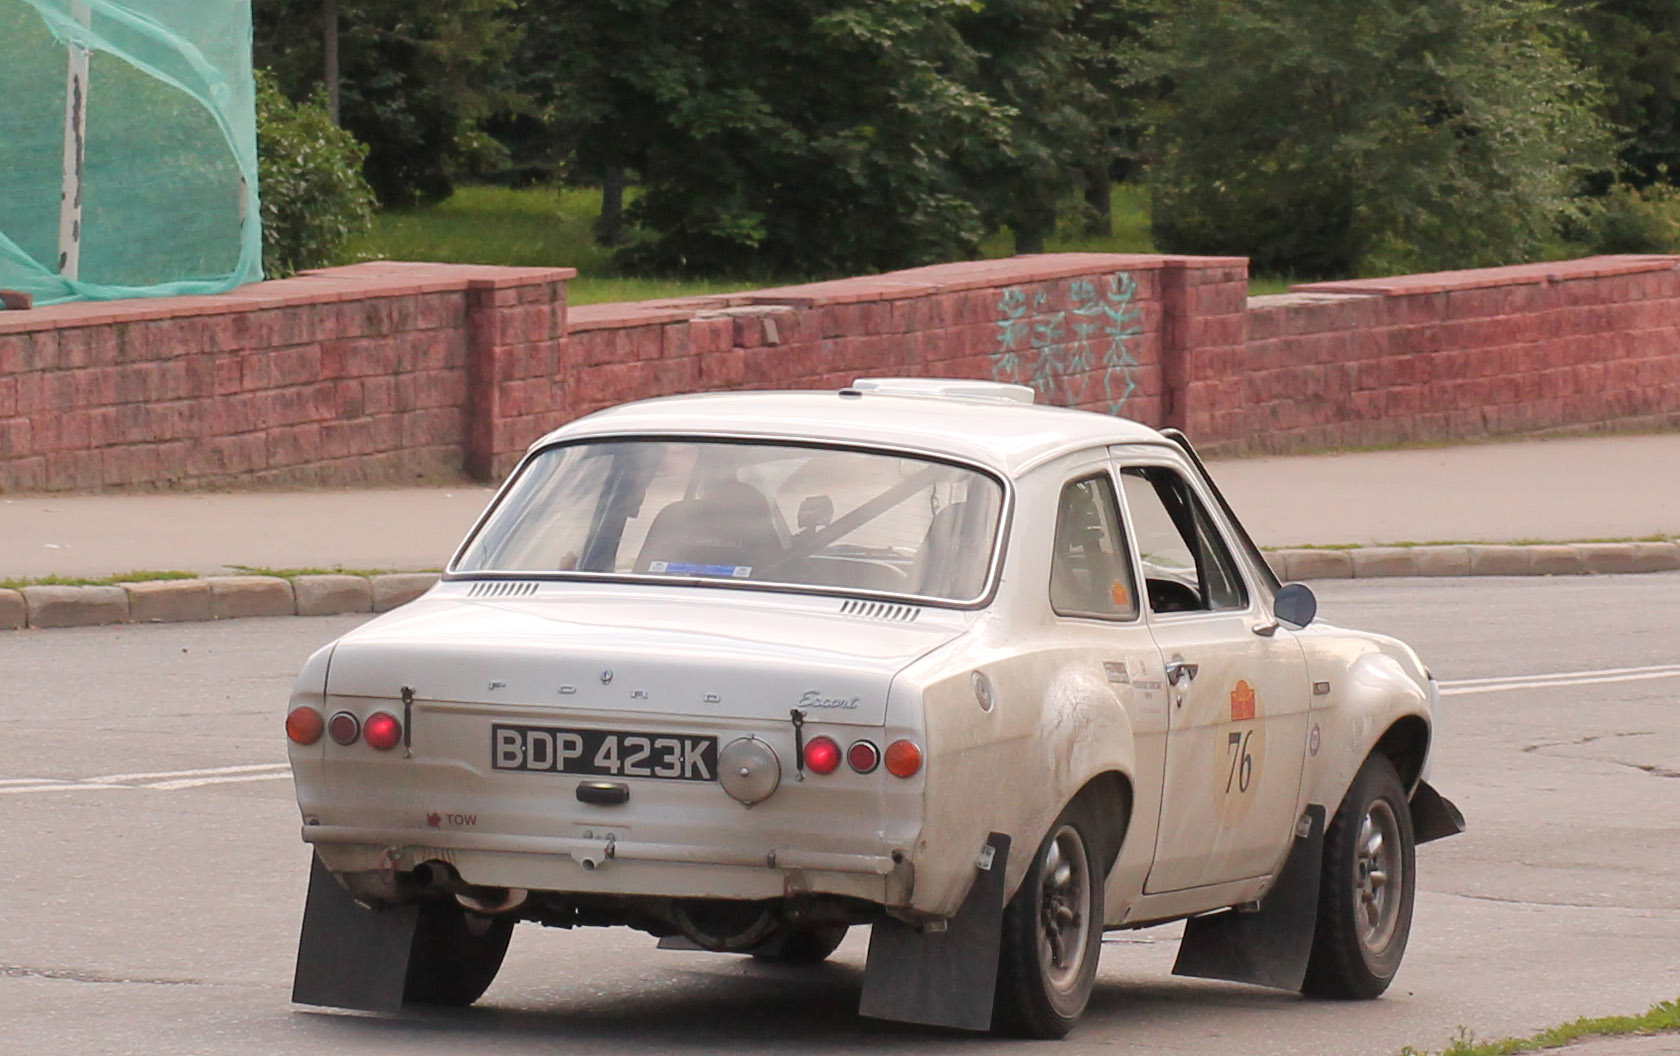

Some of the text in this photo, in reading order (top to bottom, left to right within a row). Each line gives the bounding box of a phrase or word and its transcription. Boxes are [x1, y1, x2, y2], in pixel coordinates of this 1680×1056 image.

[488, 681, 721, 703] FORD
[797, 690, 860, 709] Escort
[496, 728, 711, 780] BDP 423K
[1225, 729, 1253, 794] 76
[446, 813, 477, 826] TOW
